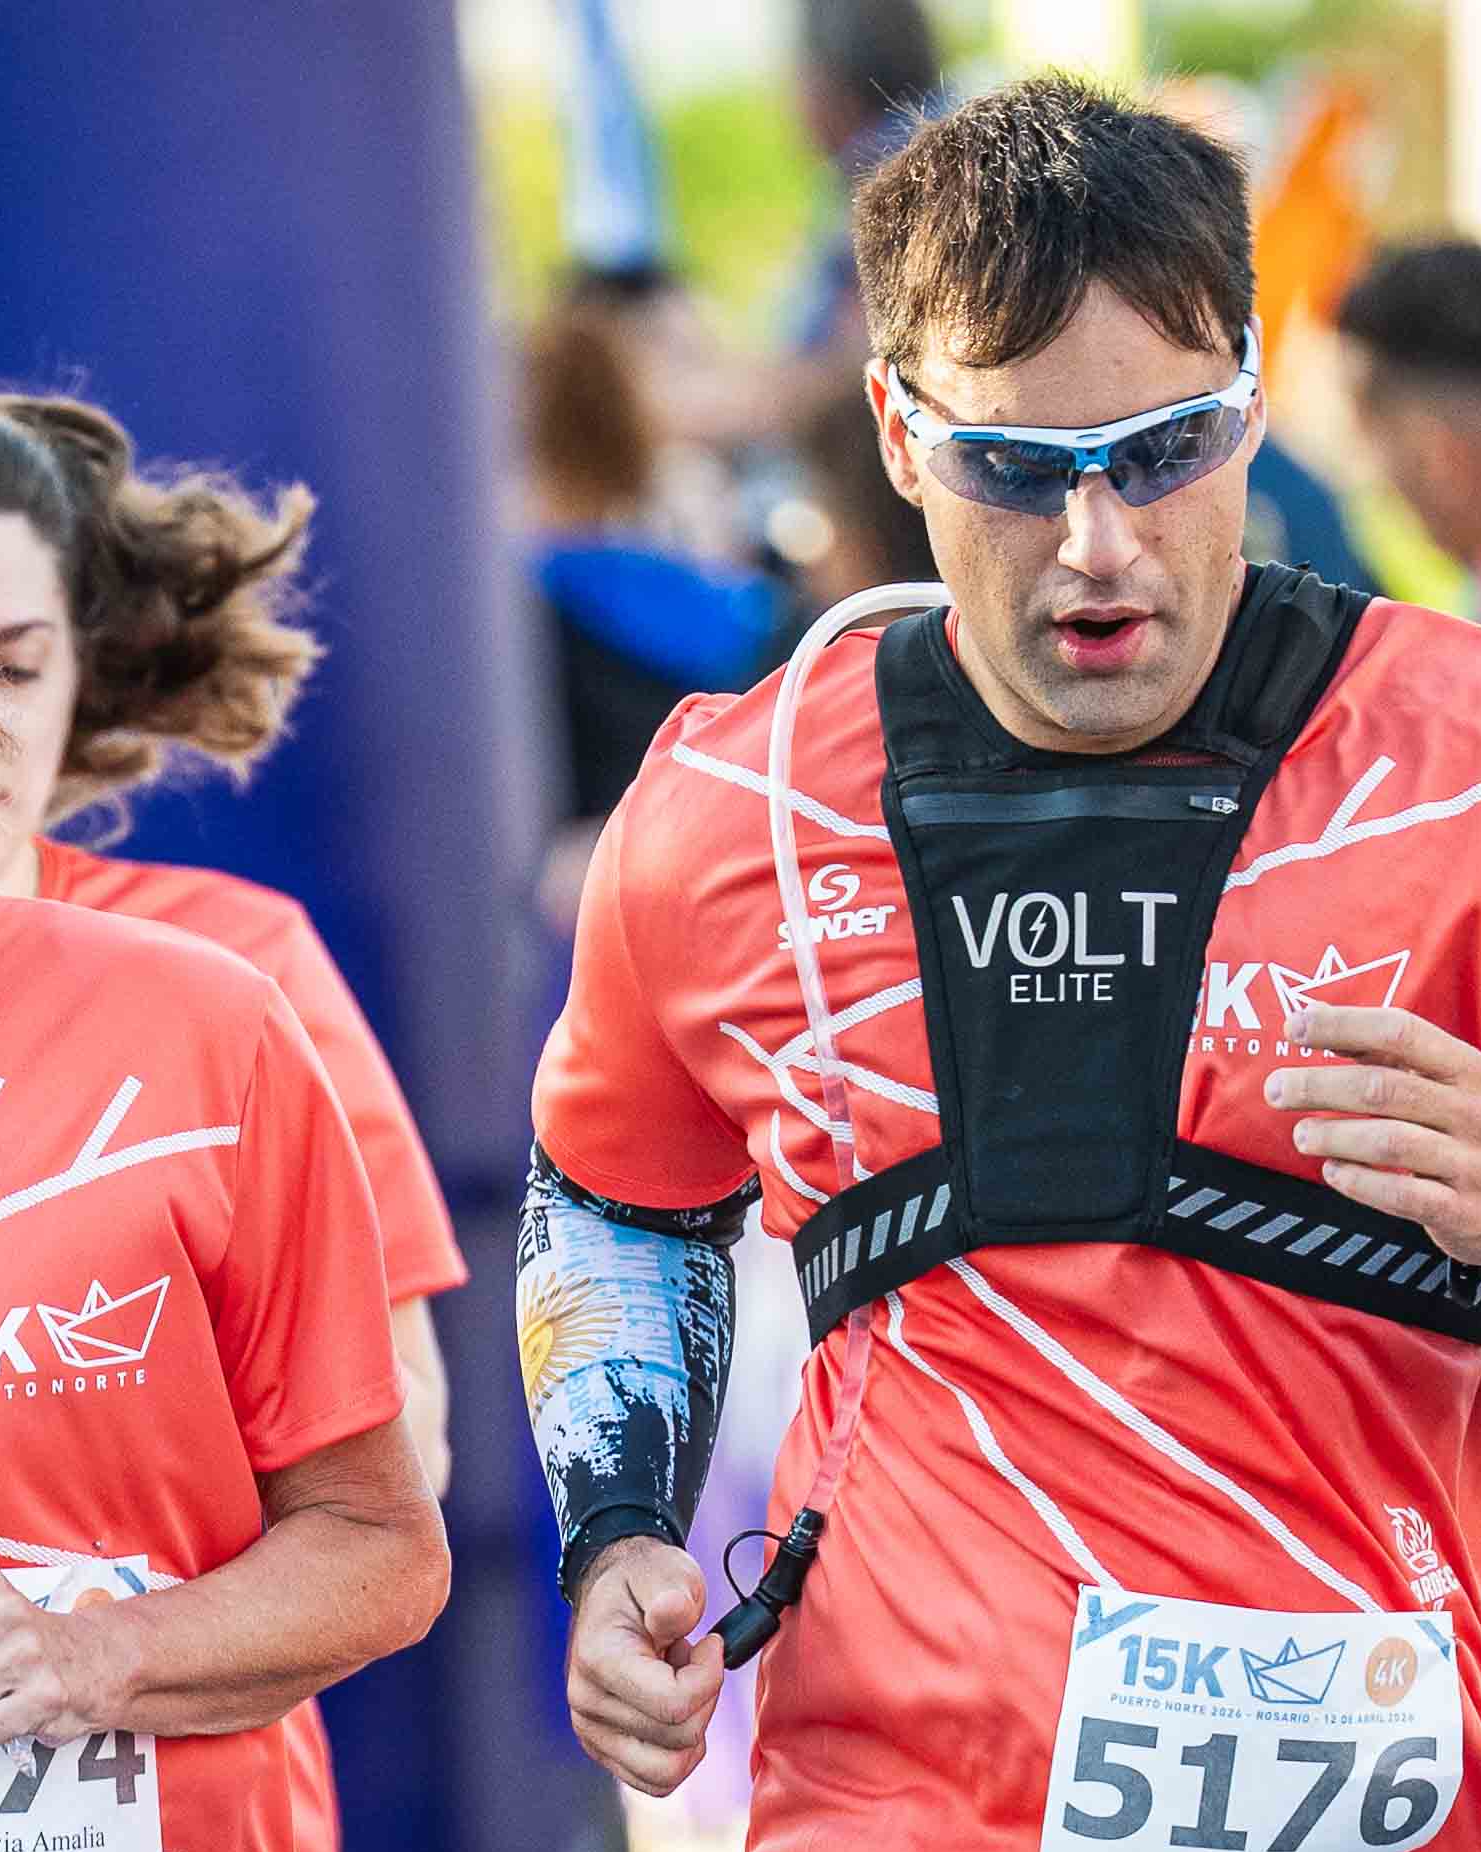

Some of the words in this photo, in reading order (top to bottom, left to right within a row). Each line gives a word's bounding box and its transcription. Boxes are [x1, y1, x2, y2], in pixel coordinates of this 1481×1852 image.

[951, 890, 1178, 969] VOLT
[1009, 972, 1114, 1004] ELITE
[50, 1368, 147, 1395] NORTE
[1117, 1634, 1231, 1698] 15K
[1372, 1659, 1407, 1687] 4K
[1110, 1693, 1161, 1708] PUERTO
[1165, 1701, 1205, 1714] NORTE
[1211, 1706, 1242, 1718] 2026
[1256, 1711, 1310, 1724] ROSARIO
[1062, 1716, 1438, 1852] 5176
[33, 1825, 106, 1852] Amalia
